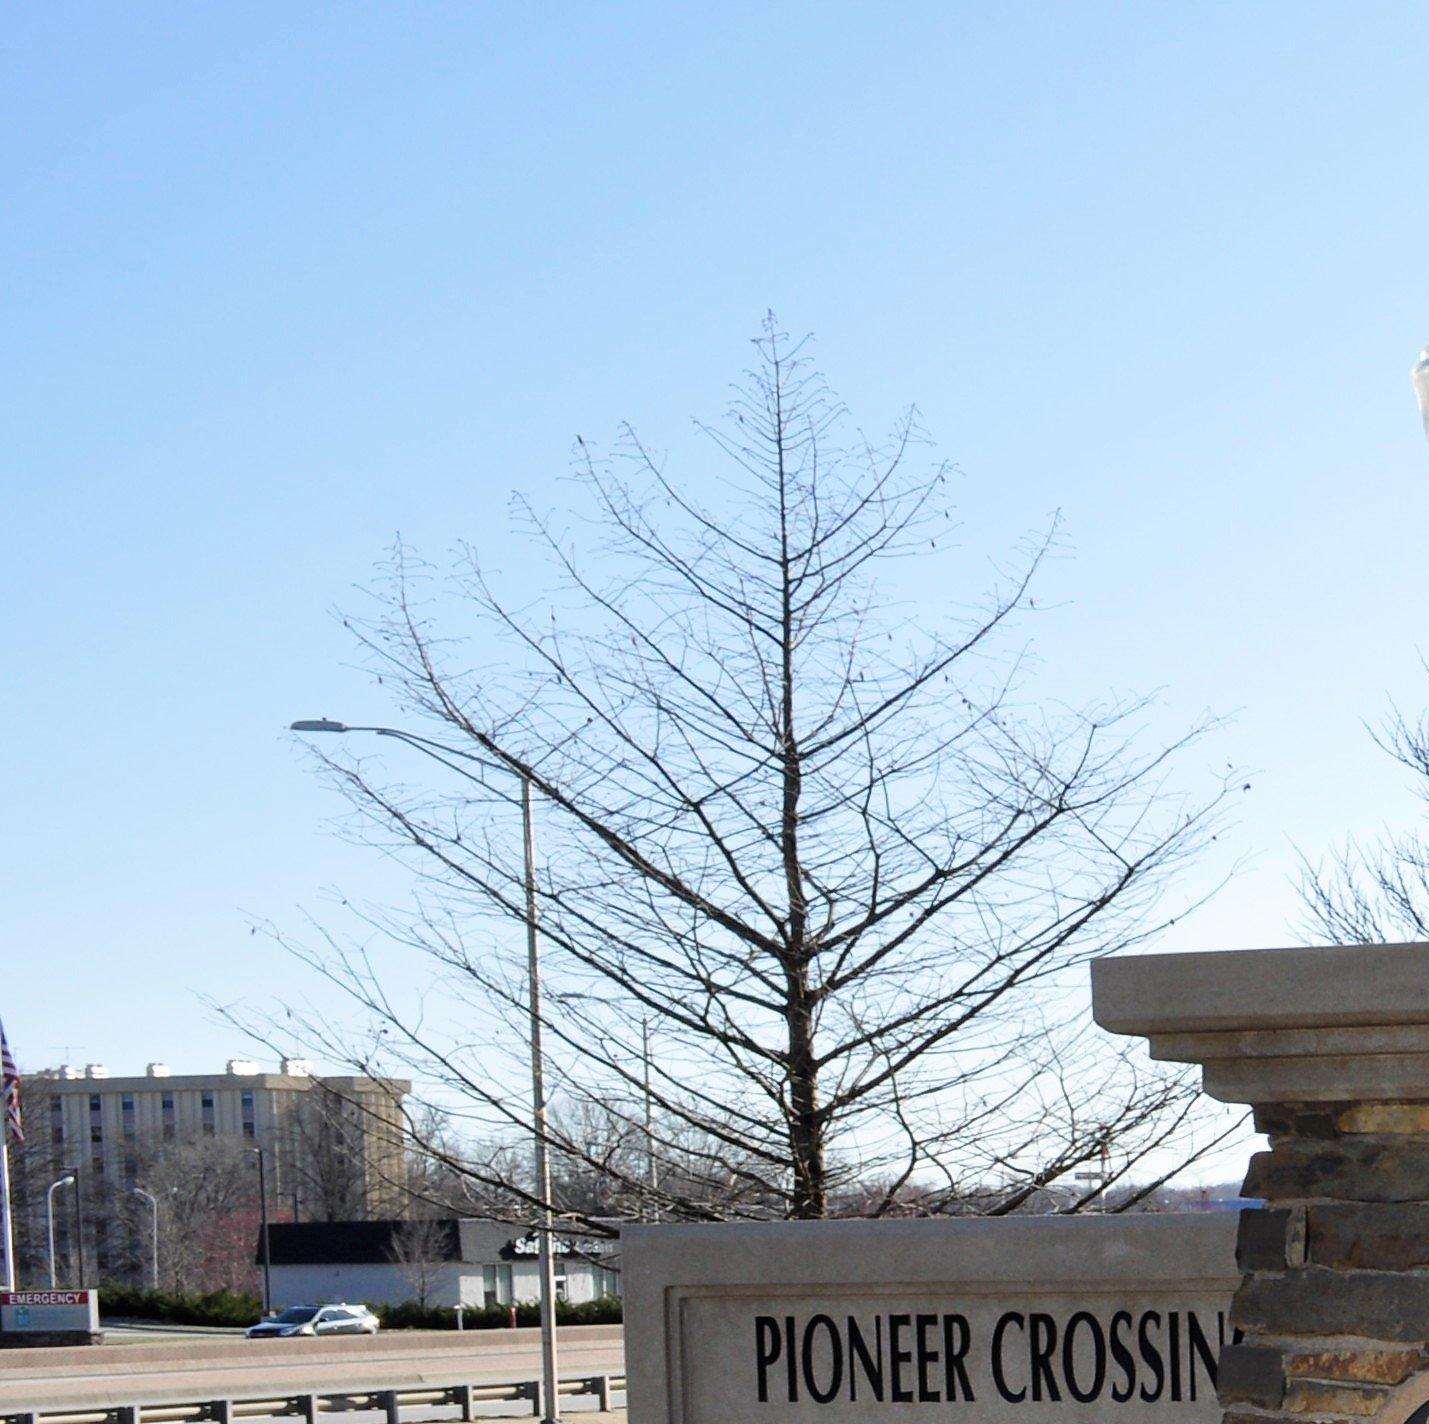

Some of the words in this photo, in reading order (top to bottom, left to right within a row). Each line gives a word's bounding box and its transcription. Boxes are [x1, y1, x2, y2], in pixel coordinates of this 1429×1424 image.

[9, 1293, 81, 1305] EMERGENCY
[755, 1314, 975, 1404] PIONEER
[991, 1310, 1245, 1403] CROSSIN
